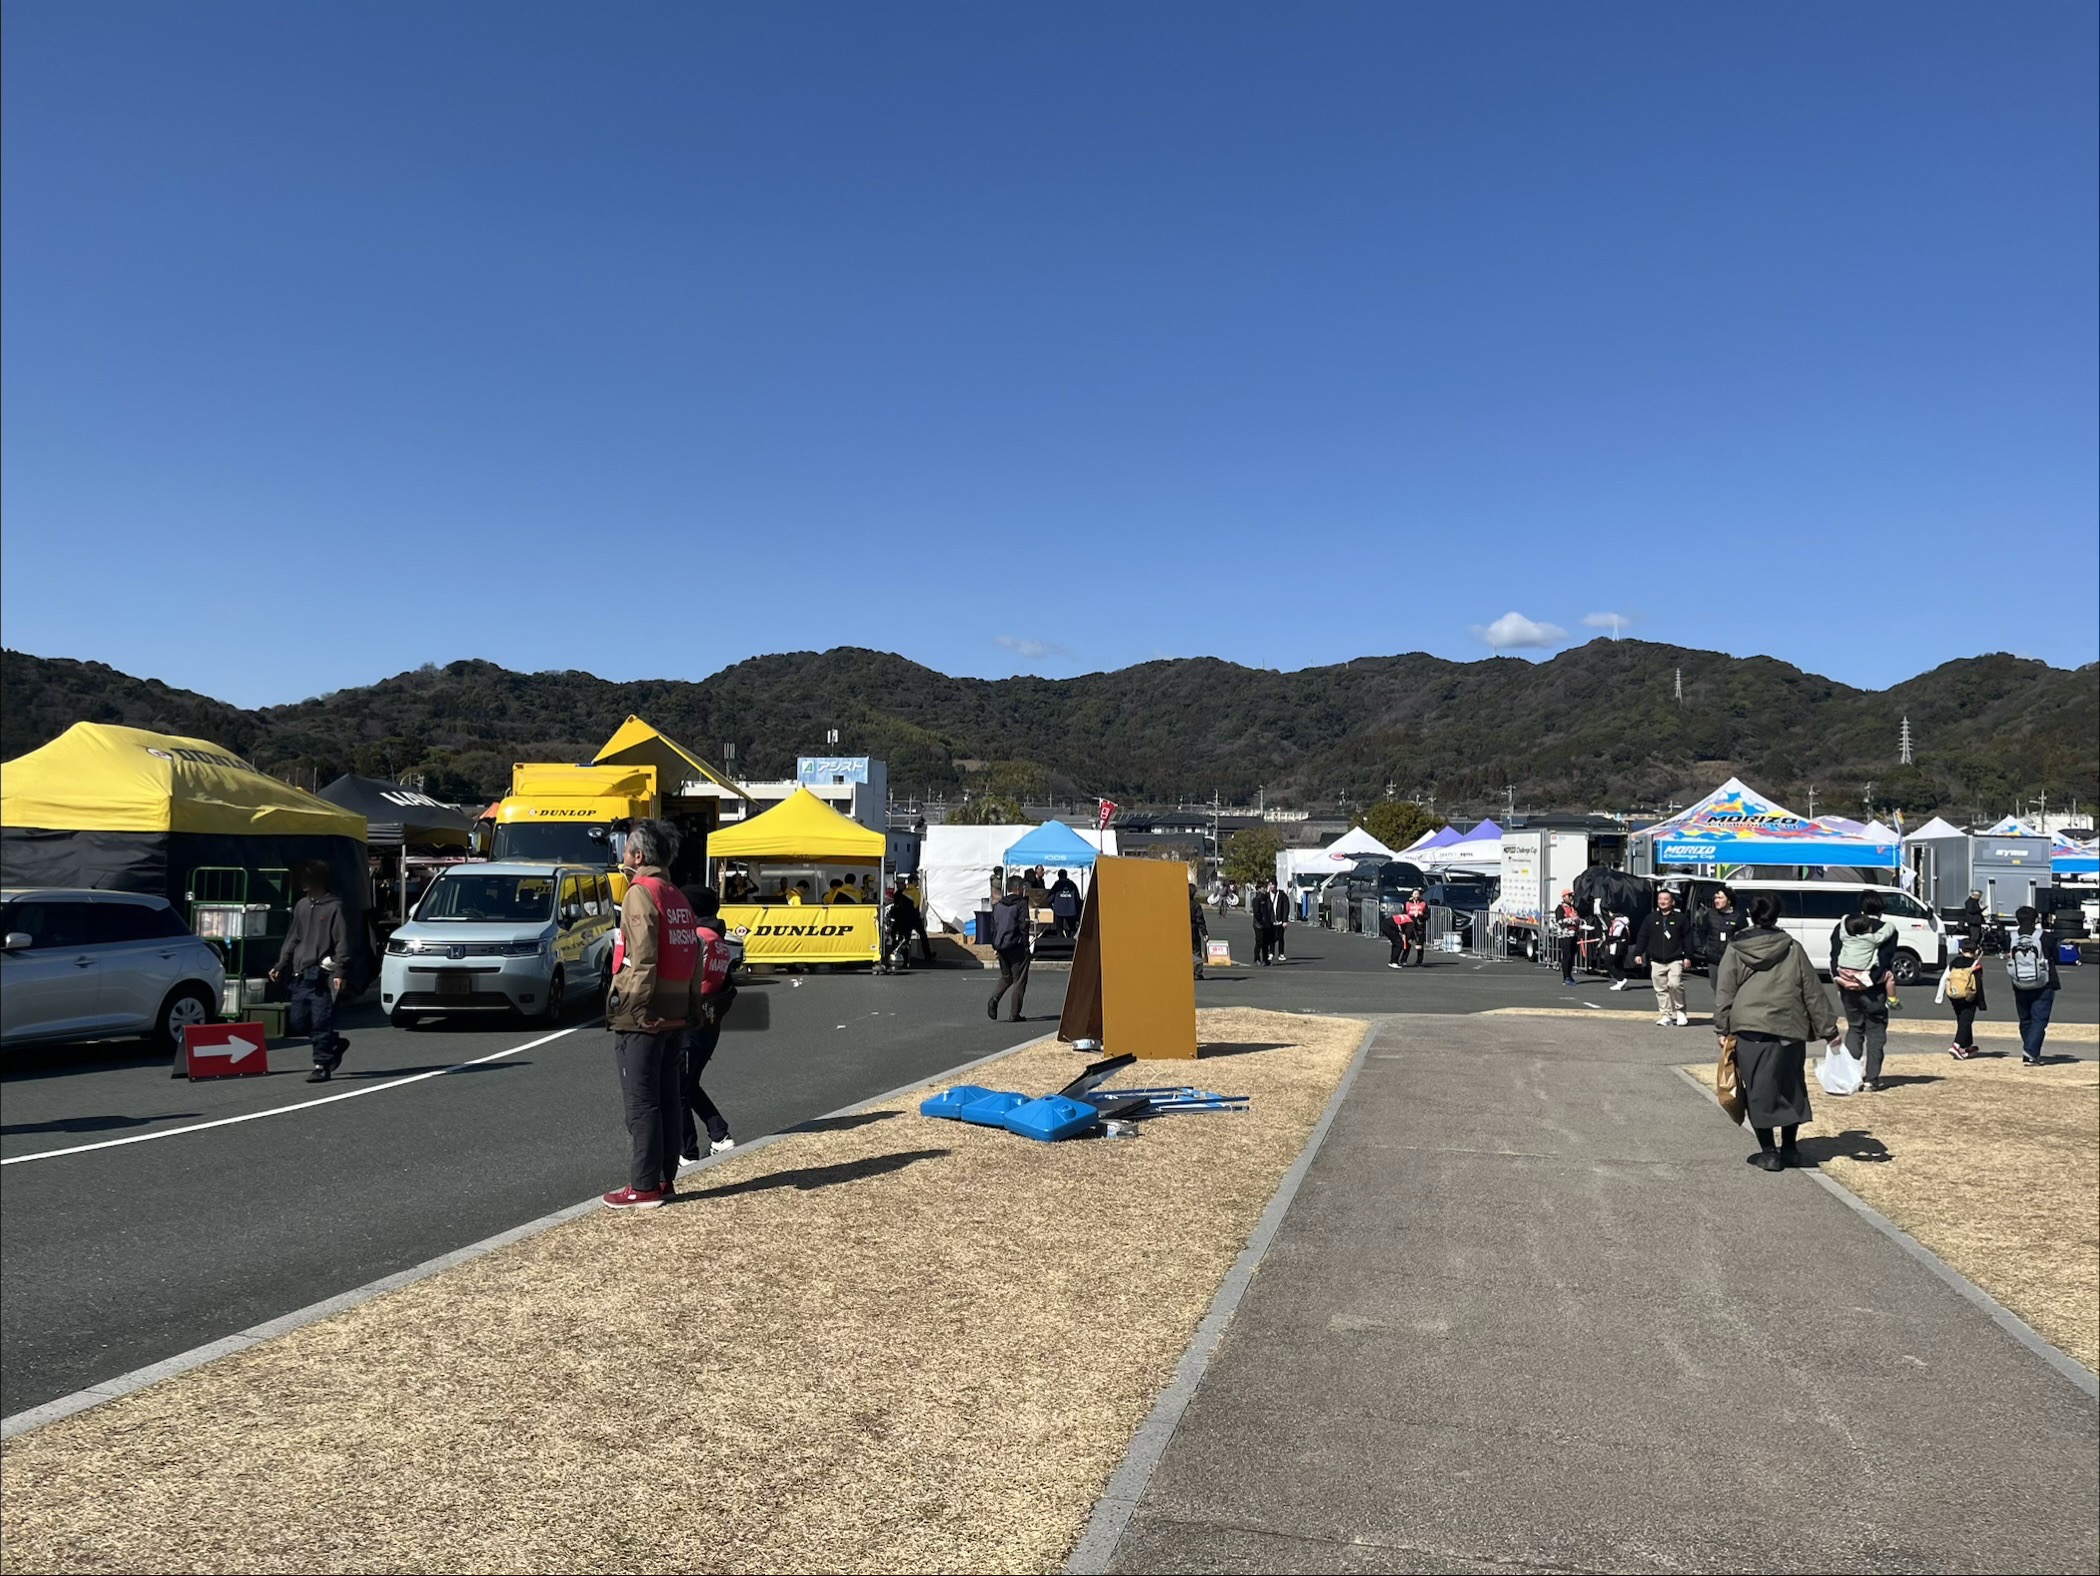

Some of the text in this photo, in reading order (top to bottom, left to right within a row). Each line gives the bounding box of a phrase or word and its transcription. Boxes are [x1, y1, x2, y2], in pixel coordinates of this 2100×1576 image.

[170, 748, 258, 773] DUNLO
[818, 761, 864, 773] アシスト
[539, 809, 597, 817] DUNLOP
[1706, 815, 1798, 825] MORIZO
[1664, 845, 1717, 855] MORIZO
[668, 928, 699, 945] MARSHA
[753, 925, 854, 937] DUNLOP
